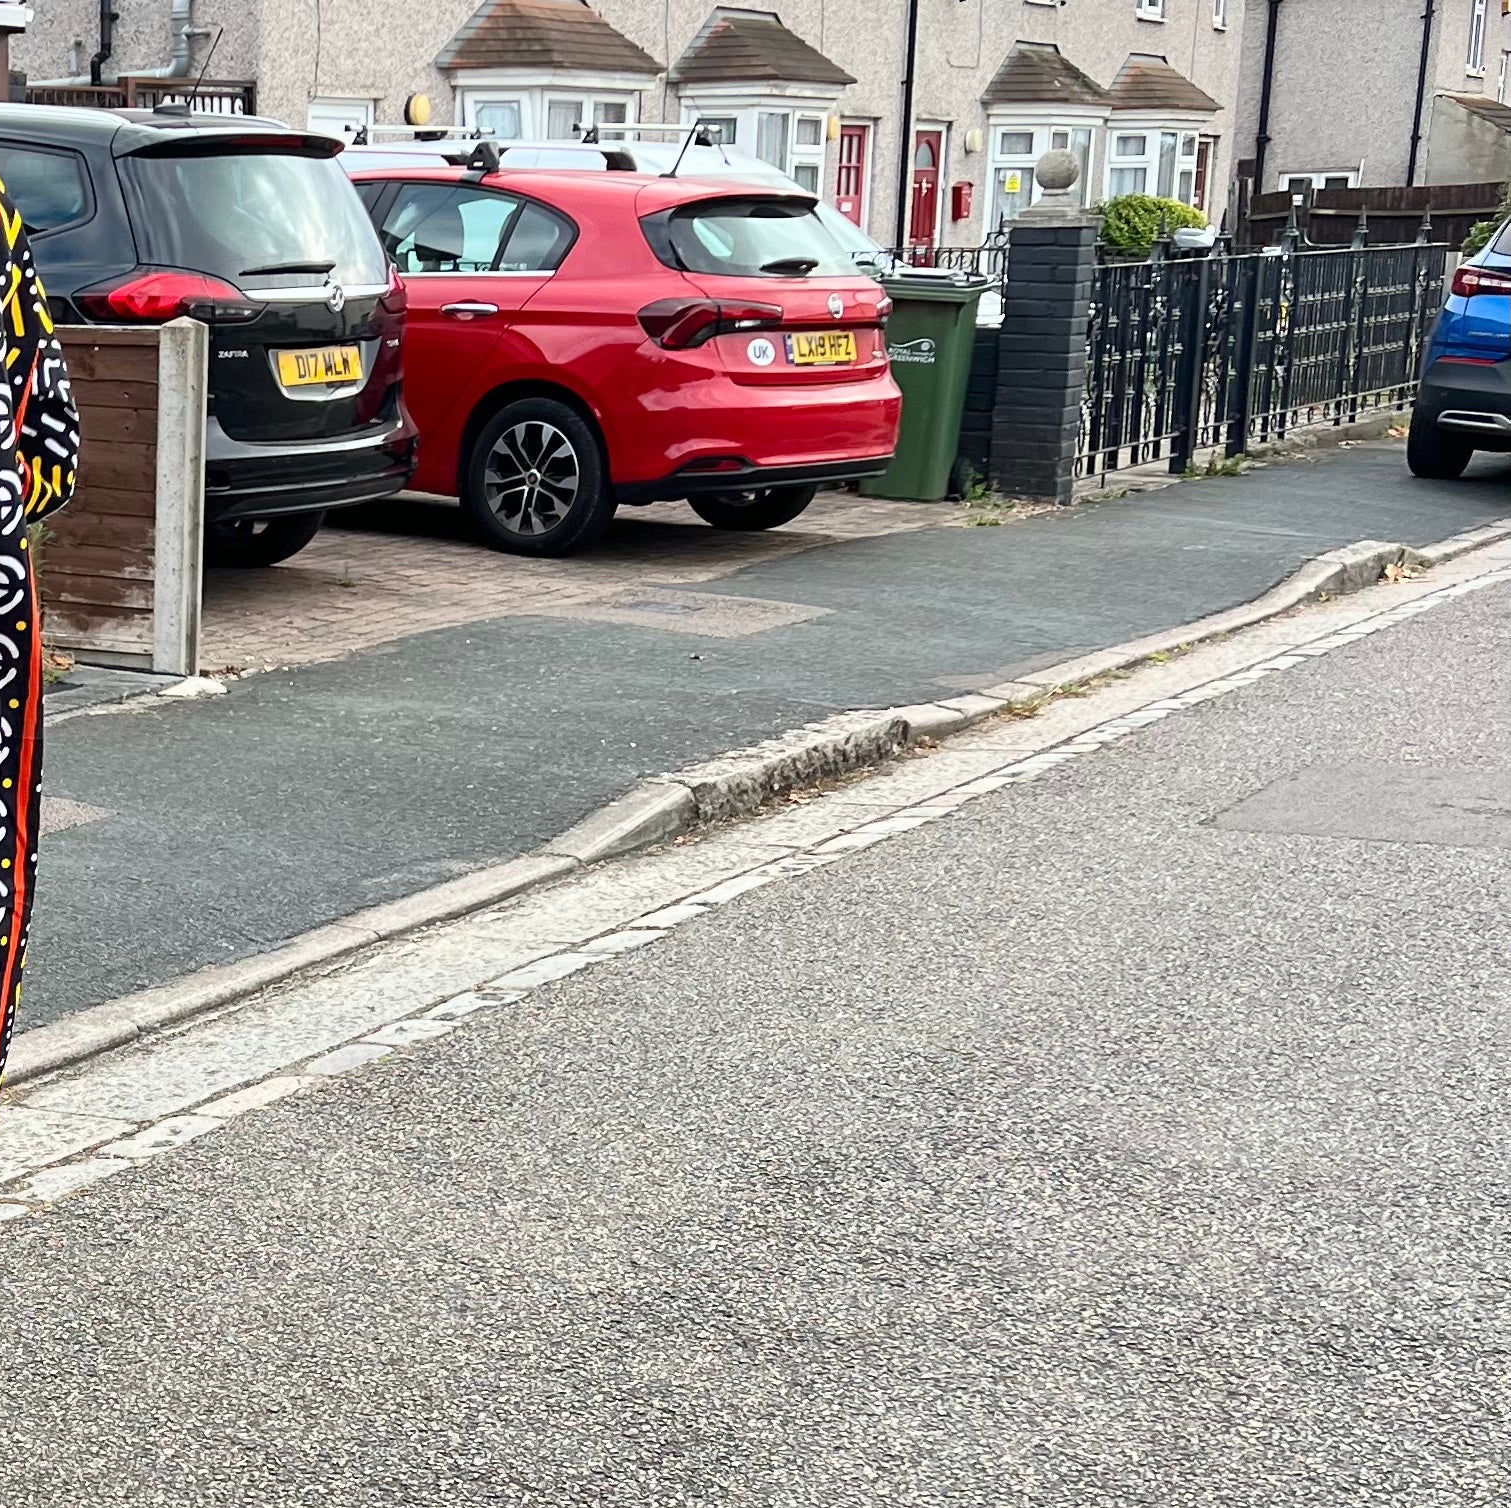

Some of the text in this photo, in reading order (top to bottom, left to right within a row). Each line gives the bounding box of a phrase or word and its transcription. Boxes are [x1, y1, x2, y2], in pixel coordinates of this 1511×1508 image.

[753, 345, 769, 359] UK
[796, 334, 852, 357] LX19 HFZ
[295, 353, 318, 378] D17
